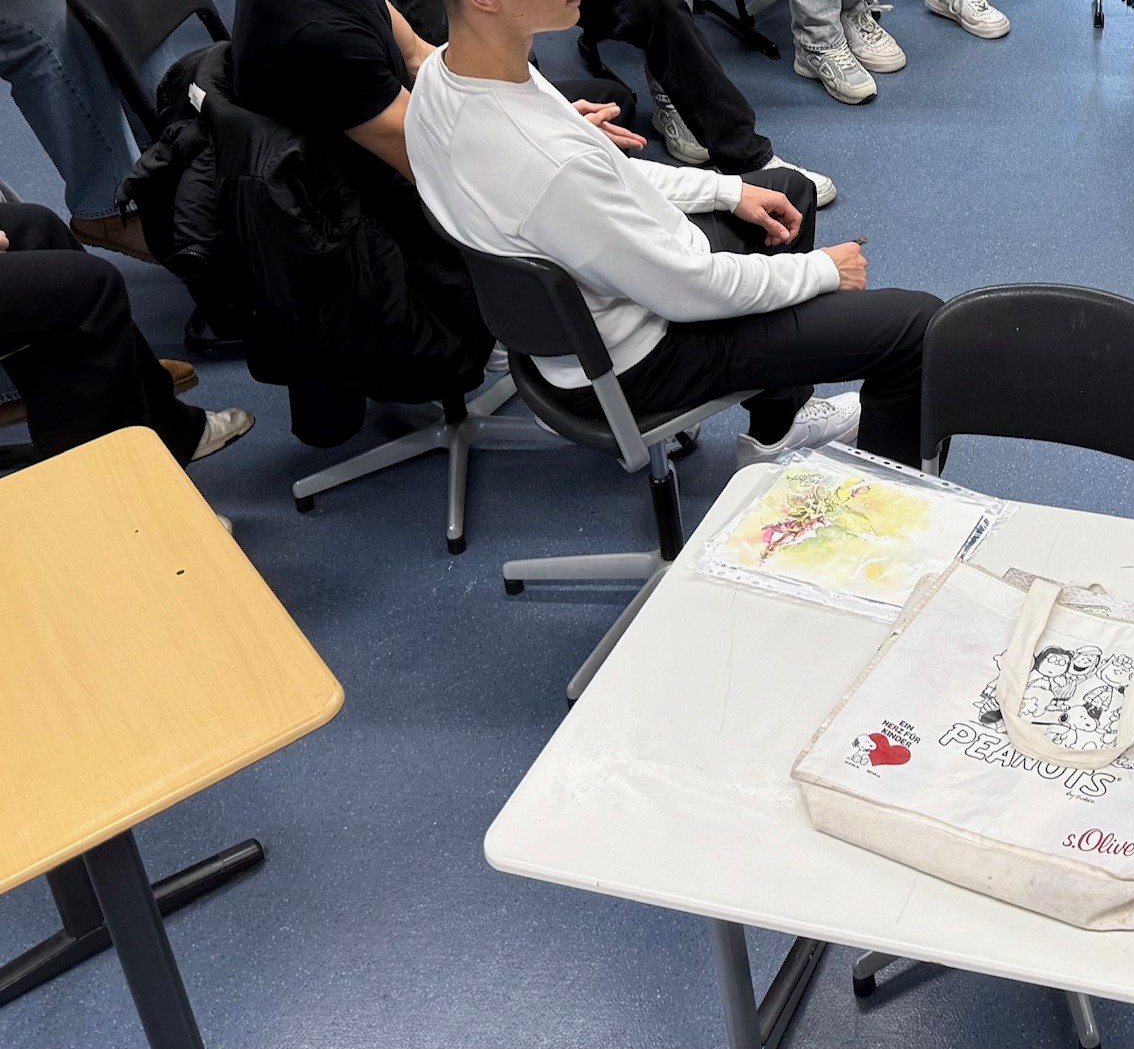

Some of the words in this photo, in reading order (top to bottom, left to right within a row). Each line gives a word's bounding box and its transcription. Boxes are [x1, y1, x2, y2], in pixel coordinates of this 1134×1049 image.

[882, 719, 904, 734] HERZ
[904, 732, 921, 744] FÜR
[899, 720, 914, 731] EIN
[881, 728, 912, 748] KINDER
[938, 722, 1116, 797] PEANUTS
